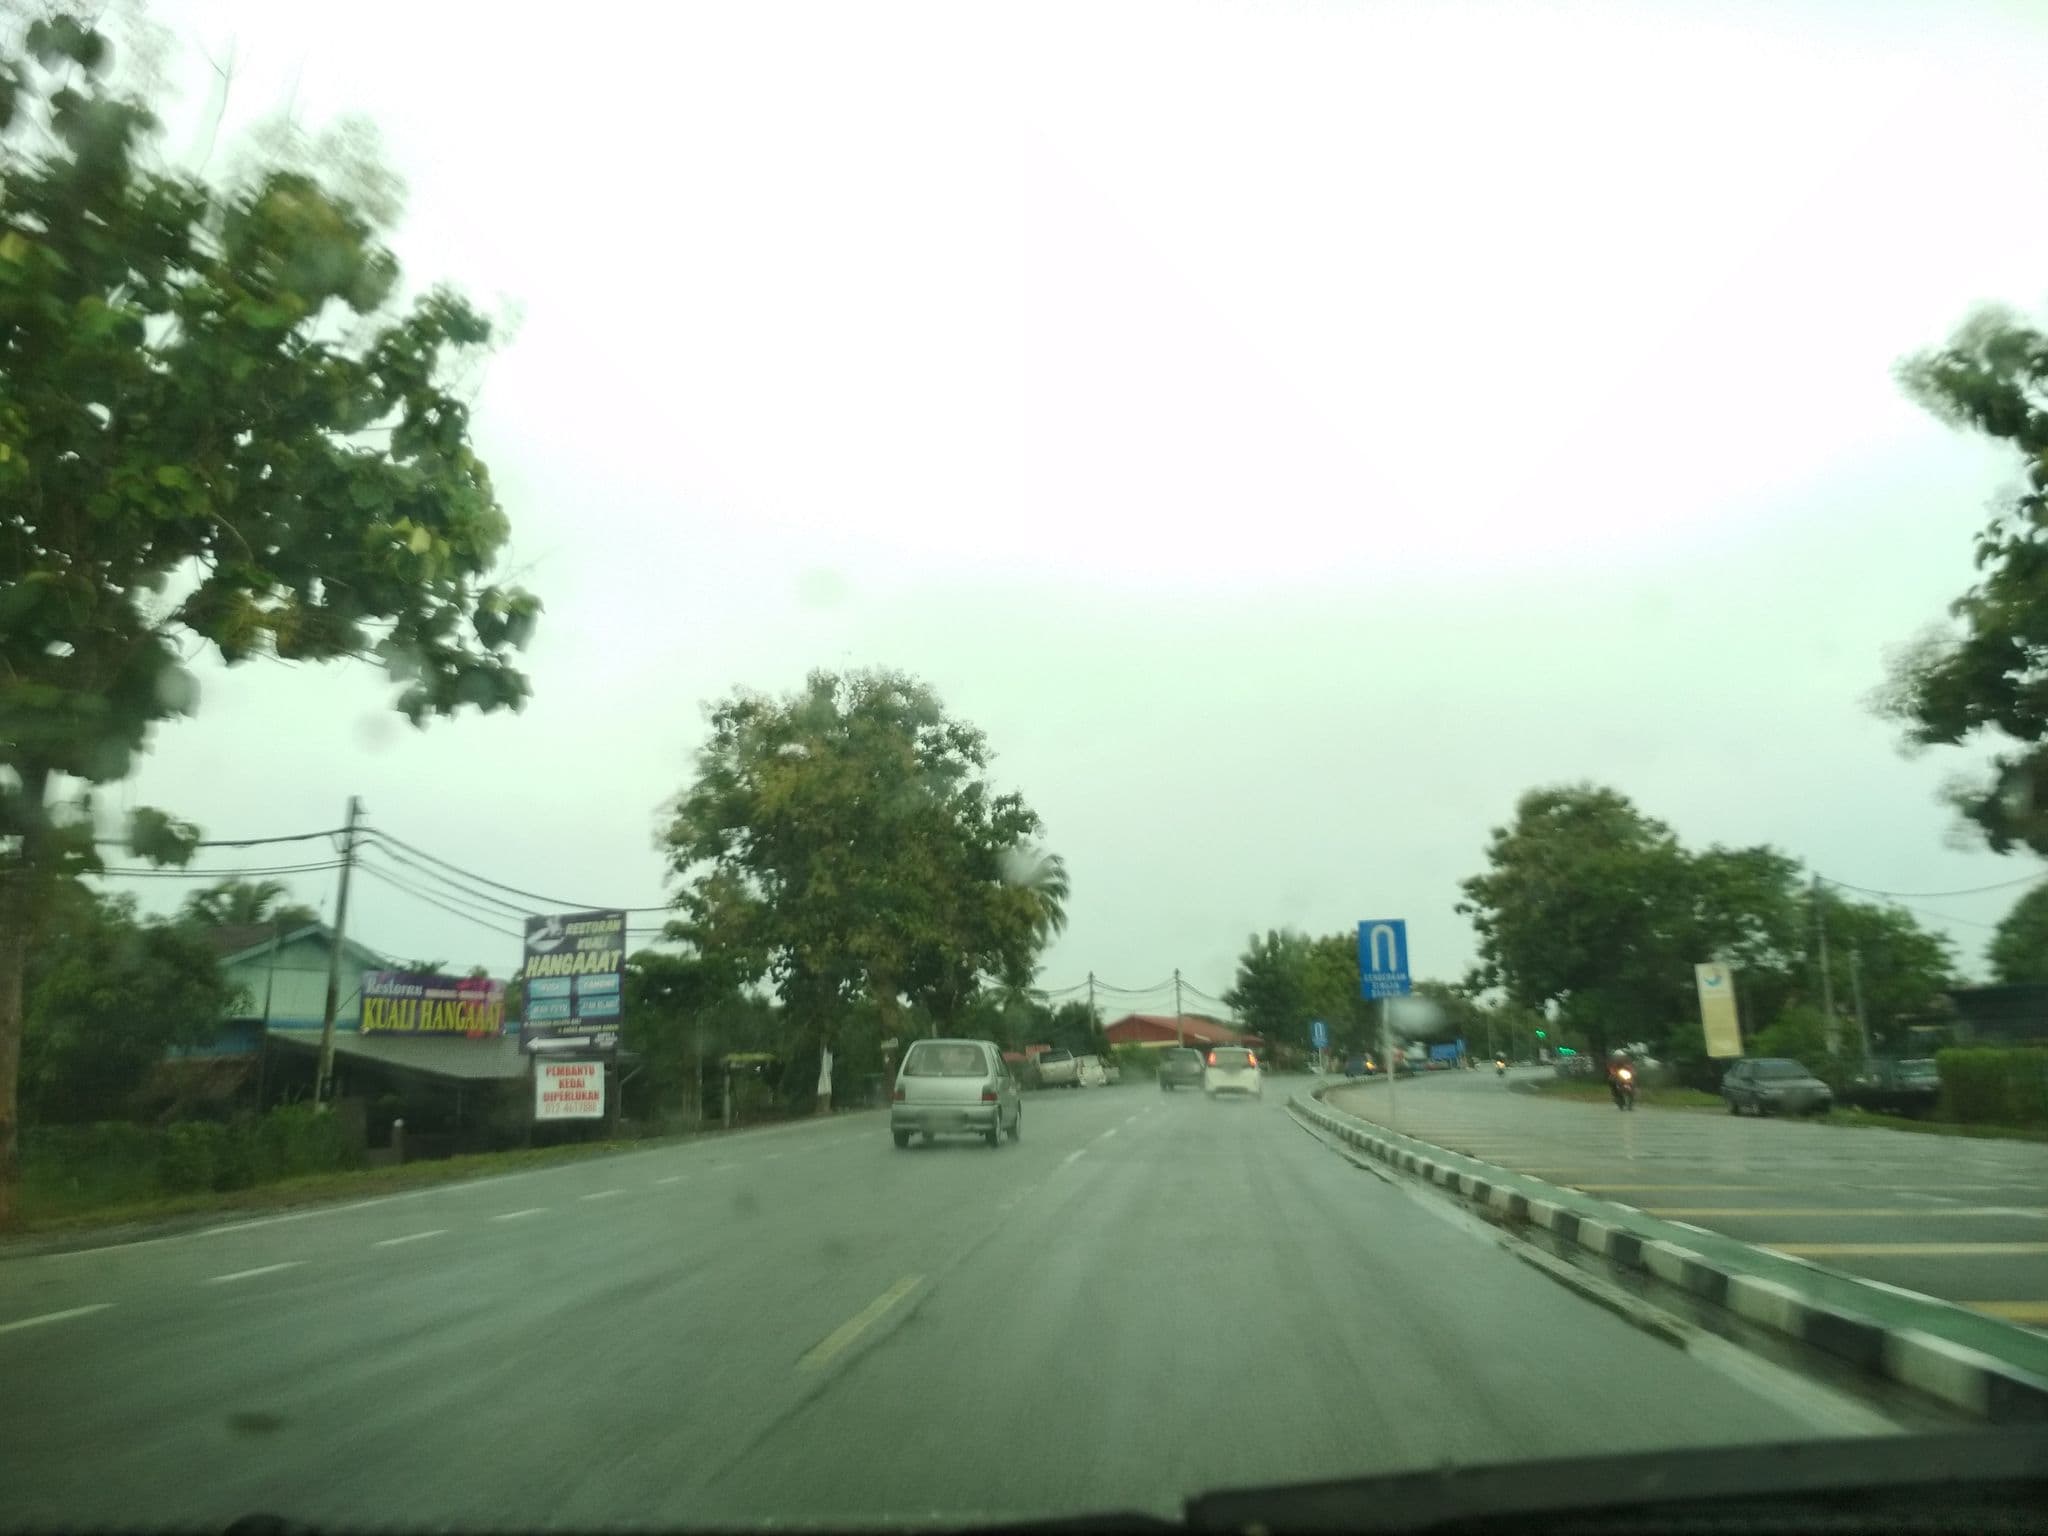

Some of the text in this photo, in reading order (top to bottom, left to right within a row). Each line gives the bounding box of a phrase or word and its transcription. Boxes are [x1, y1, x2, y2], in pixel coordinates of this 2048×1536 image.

[566, 920, 621, 936] RESTORAN
[526, 950, 622, 977] HANGAAAT
[366, 977, 423, 997] Restoran
[363, 997, 504, 1033] KUALI HANGAAAT
[546, 1065, 596, 1076] PEMBANTU
[559, 1078, 585, 1089] KEDAI
[544, 1090, 600, 1102] DIPERLUKAN
